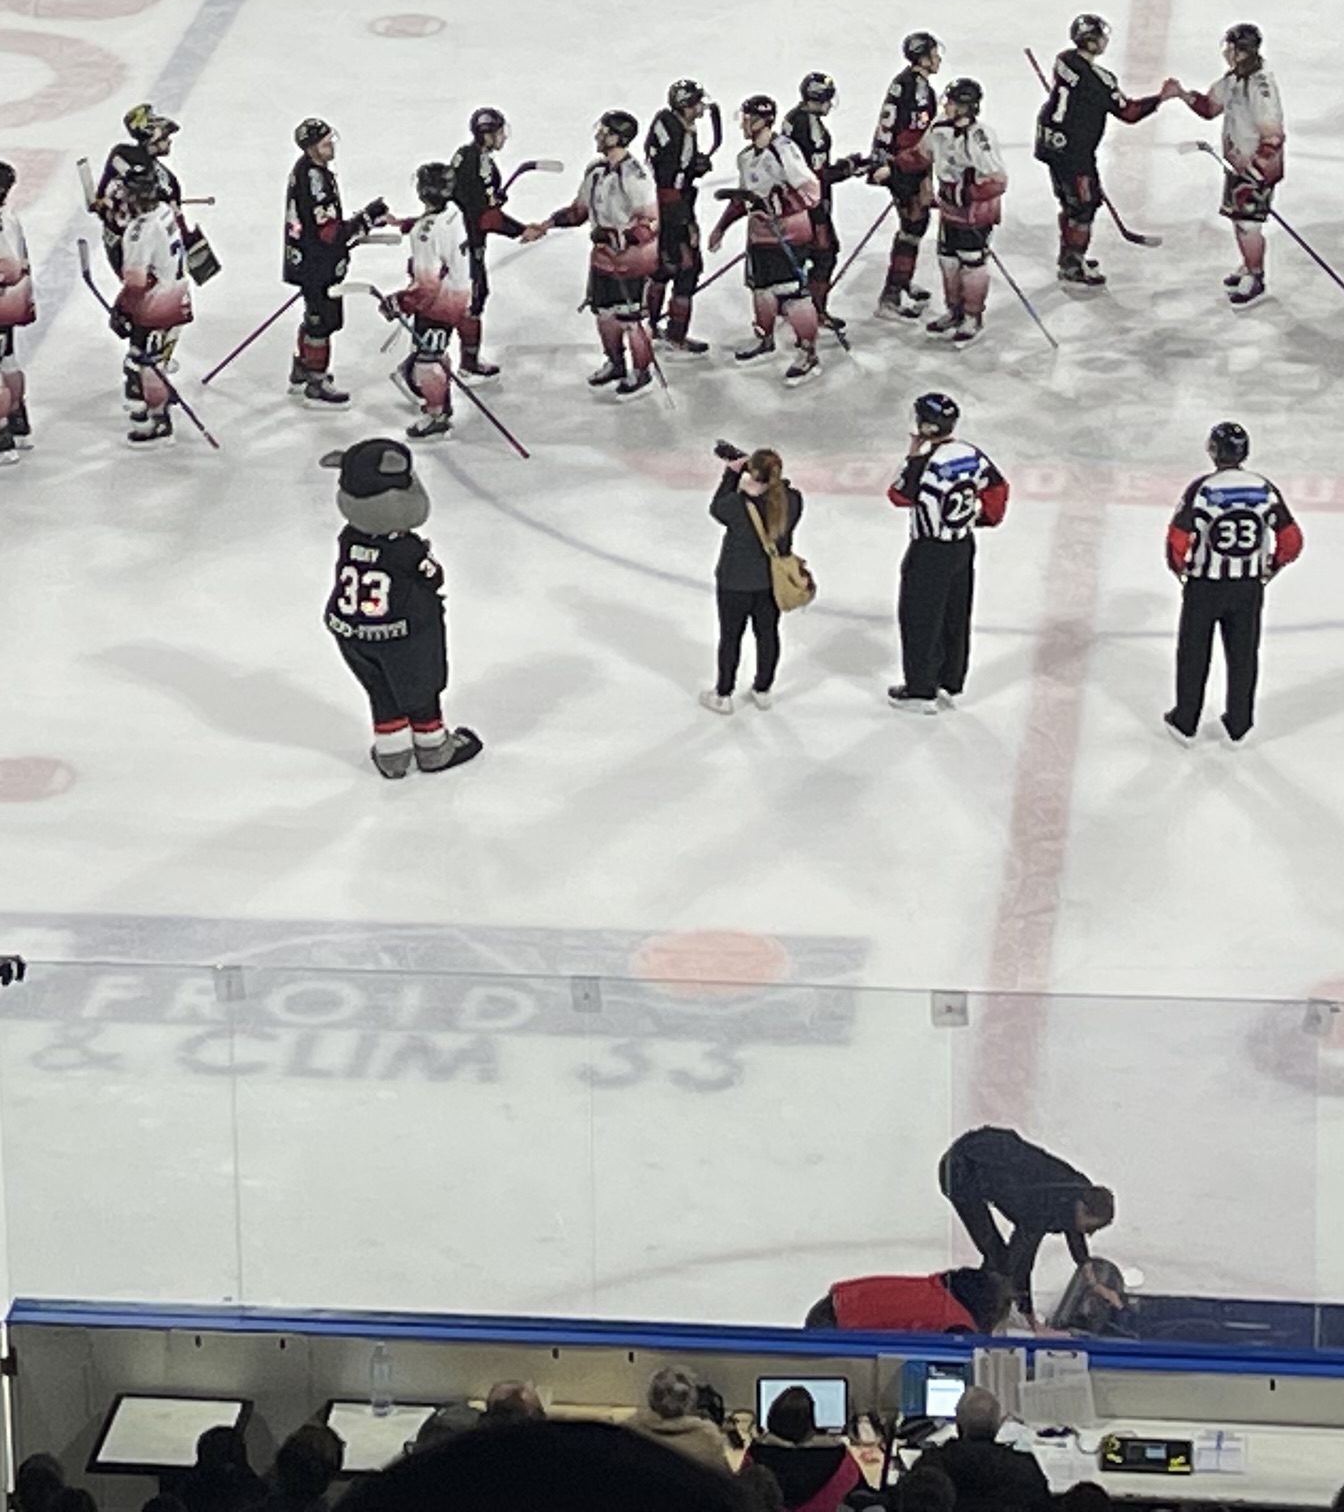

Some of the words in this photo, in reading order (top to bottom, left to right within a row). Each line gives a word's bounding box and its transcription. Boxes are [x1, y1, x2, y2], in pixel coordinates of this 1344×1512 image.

[949, 487, 975, 522] 23
[1217, 519, 1257, 550] 33
[336, 565, 392, 618] 33
[82, 974, 540, 1031] FROID
[30, 1026, 126, 1073] &
[175, 1030, 505, 1083] CLIM
[577, 1034, 744, 1090] 33
